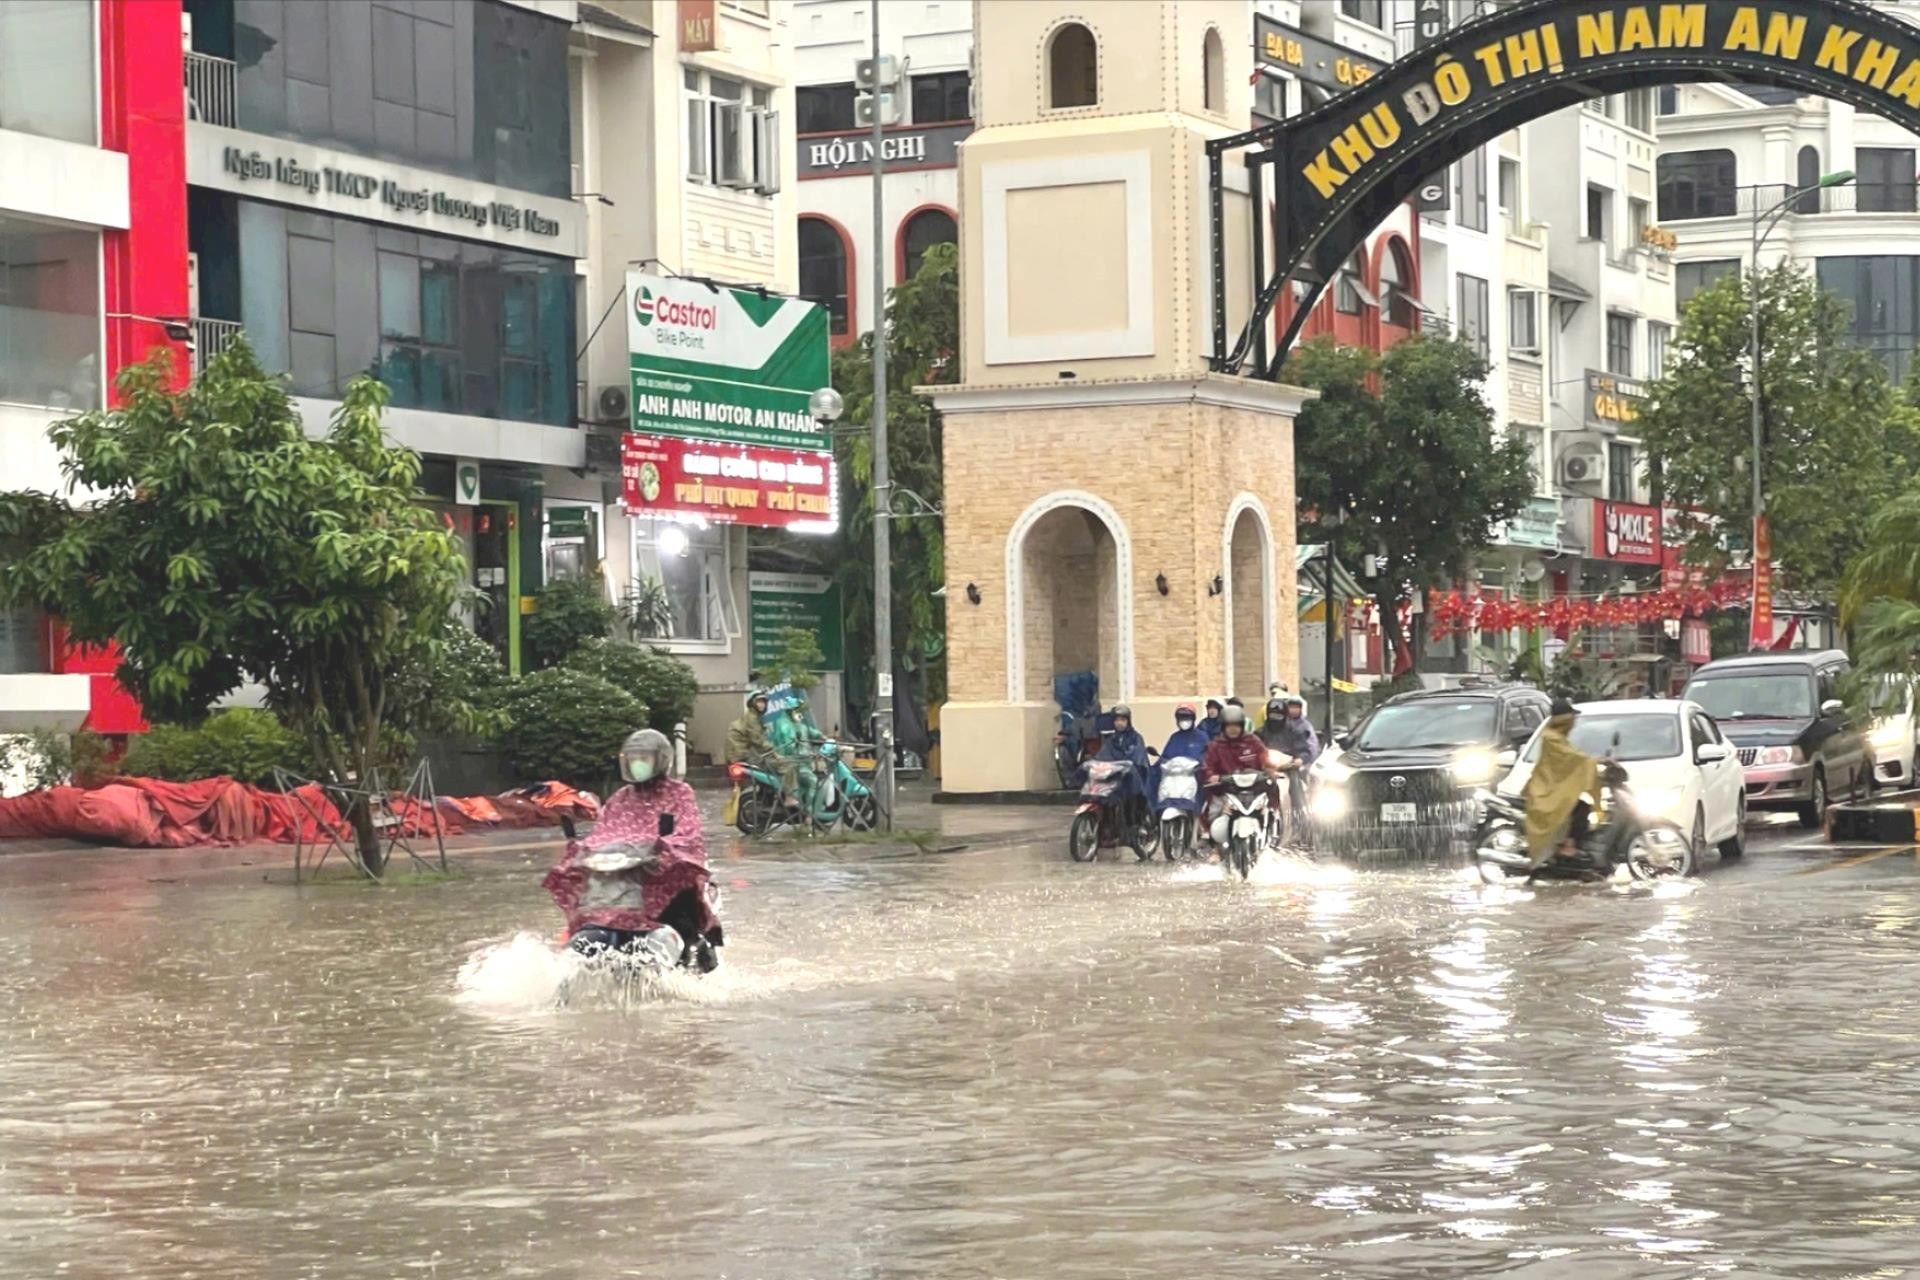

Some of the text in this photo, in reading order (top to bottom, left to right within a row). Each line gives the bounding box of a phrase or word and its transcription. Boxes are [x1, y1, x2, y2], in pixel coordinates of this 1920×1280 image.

[1302, 101, 1402, 199] KHU
[1402, 53, 1472, 126] ĐÔ
[1474, 22, 1565, 87] THỊ
[1577, 4, 1707, 58] NAM
[1722, 7, 1808, 60] AN
[809, 136, 926, 169] HỘI NGHỊ
[224, 146, 272, 181] Ngân
[276, 157, 321, 194] hàng
[323, 167, 378, 199] TMCP
[382, 180, 429, 215] Ngoại
[490, 202, 520, 231] Việt
[524, 209, 559, 236] Nam
[656, 296, 716, 330] Castrol
[656, 328, 704, 349] Bike Point
[639, 394, 669, 416] ANH
[672, 398, 702, 420] ANH
[704, 402, 752, 426] MOTOR
[755, 410, 776, 429] AN
[777, 409, 823, 433] KHÁN
[1619, 512, 1653, 544] MIXUE
